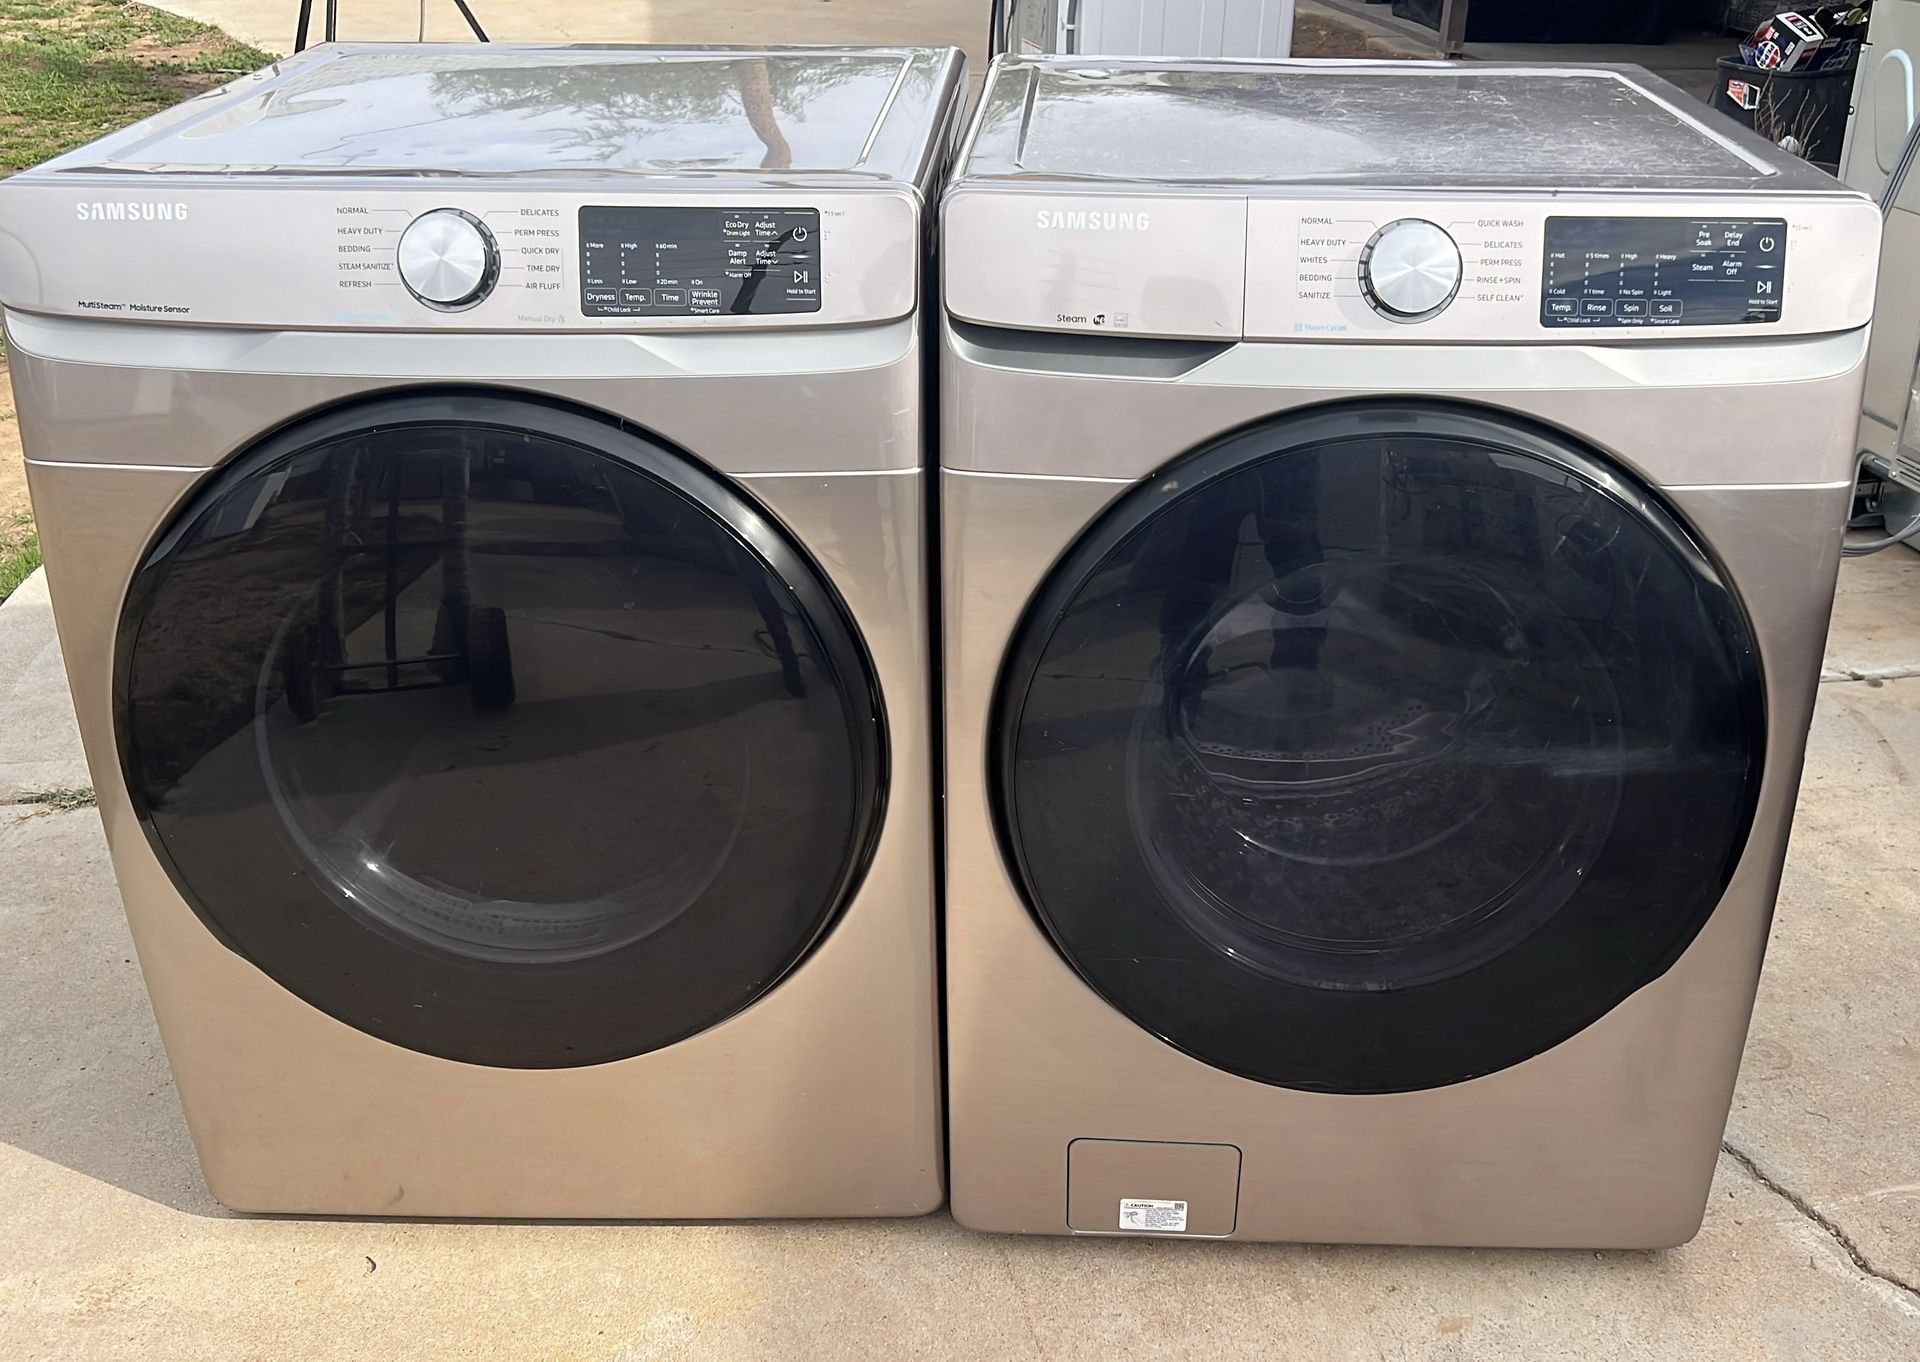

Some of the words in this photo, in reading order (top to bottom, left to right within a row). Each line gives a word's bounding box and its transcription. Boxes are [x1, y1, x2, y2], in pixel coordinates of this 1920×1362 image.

[76, 202, 188, 221] SAMSUNG
[1037, 210, 1150, 231] SAMSUNG
[1301, 217, 1333, 225] NORMAL
[1478, 220, 1500, 228] QUICK
[737, 221, 749, 229] Dry
[514, 229, 535, 237] PERM
[537, 229, 560, 237] PRESS
[1724, 232, 1742, 240] Delay
[338, 245, 371, 253] BEDDING
[521, 247, 544, 255] QUICK
[545, 247, 560, 255] DRY
[1300, 274, 1332, 282] BEDDING
[339, 280, 372, 288] REFRESH
[587, 293, 615, 302] Dryness
[625, 293, 646, 302] Temp.
[692, 291, 717, 299] Wrinkle
[129, 304, 162, 312] Moisture
[1552, 304, 1572, 312] Temp.
[1587, 304, 1606, 312] Rinse
[1624, 304, 1639, 312] Spin
[1659, 304, 1672, 312] Soil
[543, 315, 556, 323] Dry
[1057, 314, 1086, 323] Steam
